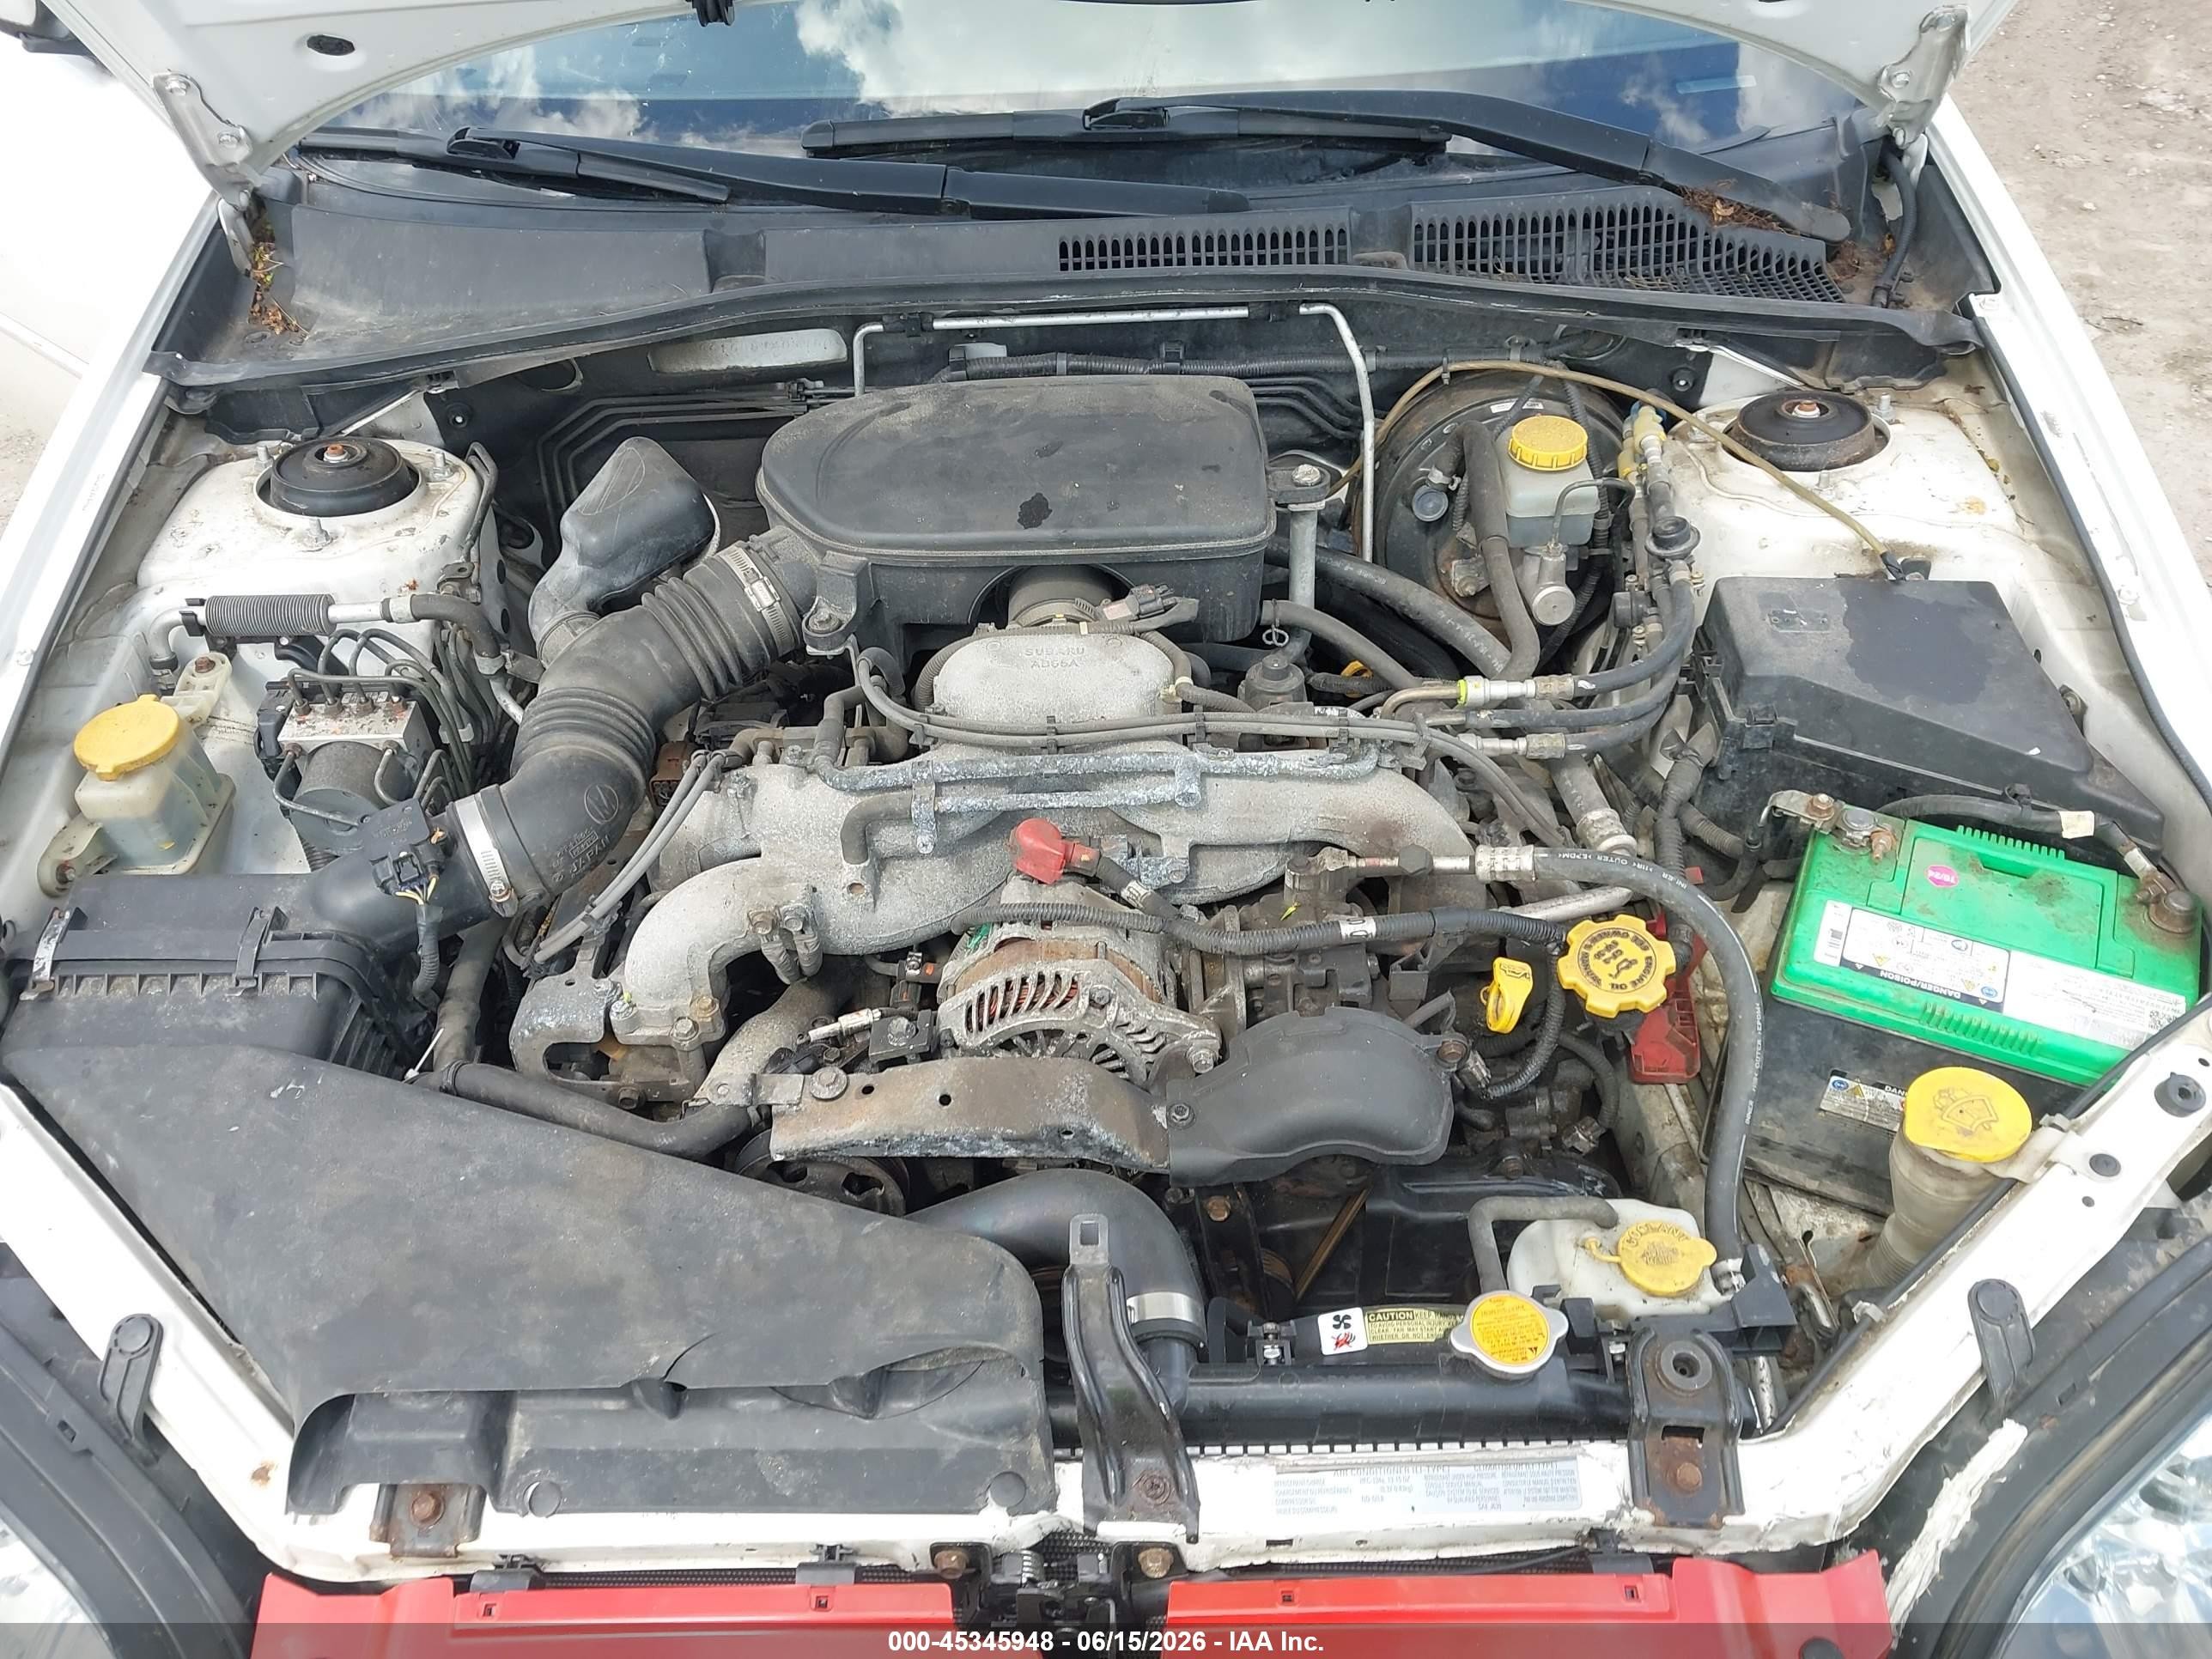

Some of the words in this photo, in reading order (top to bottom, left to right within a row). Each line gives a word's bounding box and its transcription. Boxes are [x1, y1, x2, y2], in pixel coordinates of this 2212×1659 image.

[1632, 934, 1650, 951] SEE
[1630, 955, 1653, 989] ENGINE
[1610, 981, 1628, 990] OIL
[1880, 969, 1961, 1000] DANGER/POISON
[1369, 1311, 1413, 1322] CAUTION
